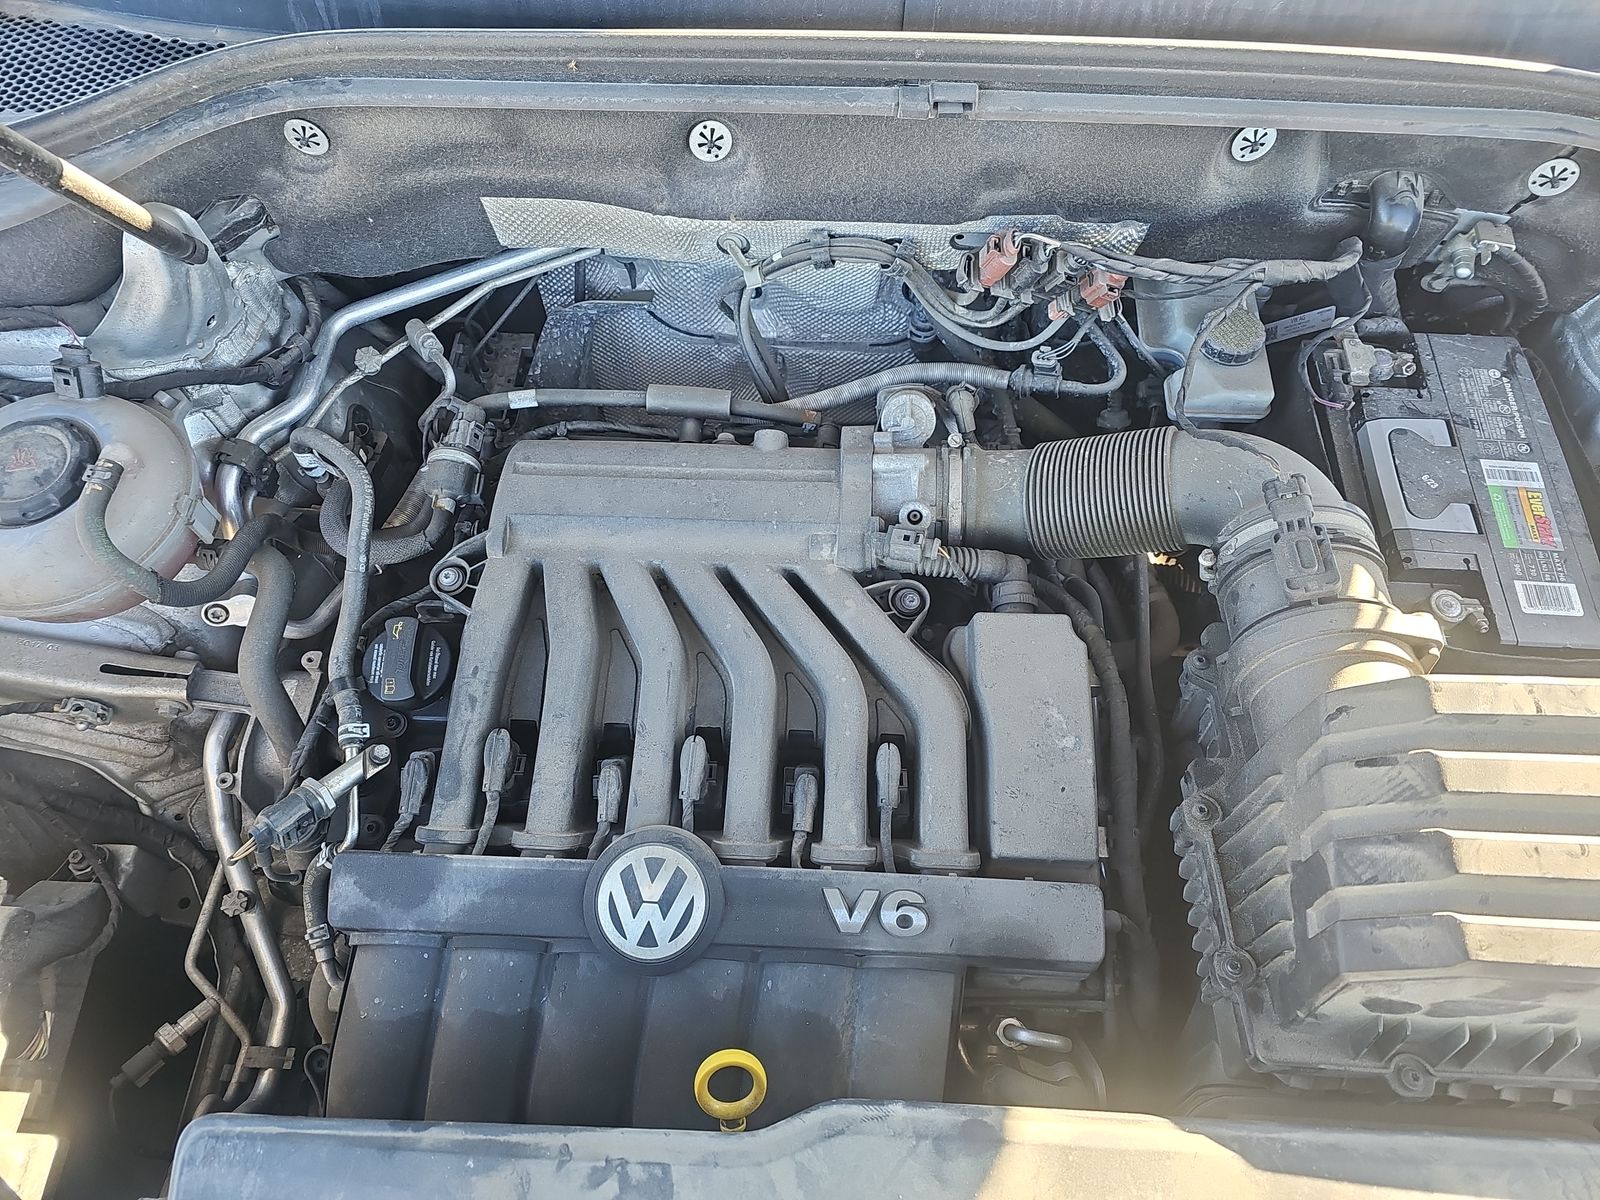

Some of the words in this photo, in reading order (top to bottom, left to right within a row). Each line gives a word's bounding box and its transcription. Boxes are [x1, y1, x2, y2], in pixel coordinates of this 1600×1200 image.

[1421, 474, 1439, 489] 6/23
[597, 845, 706, 960] VW
[821, 887, 930, 937] V6
